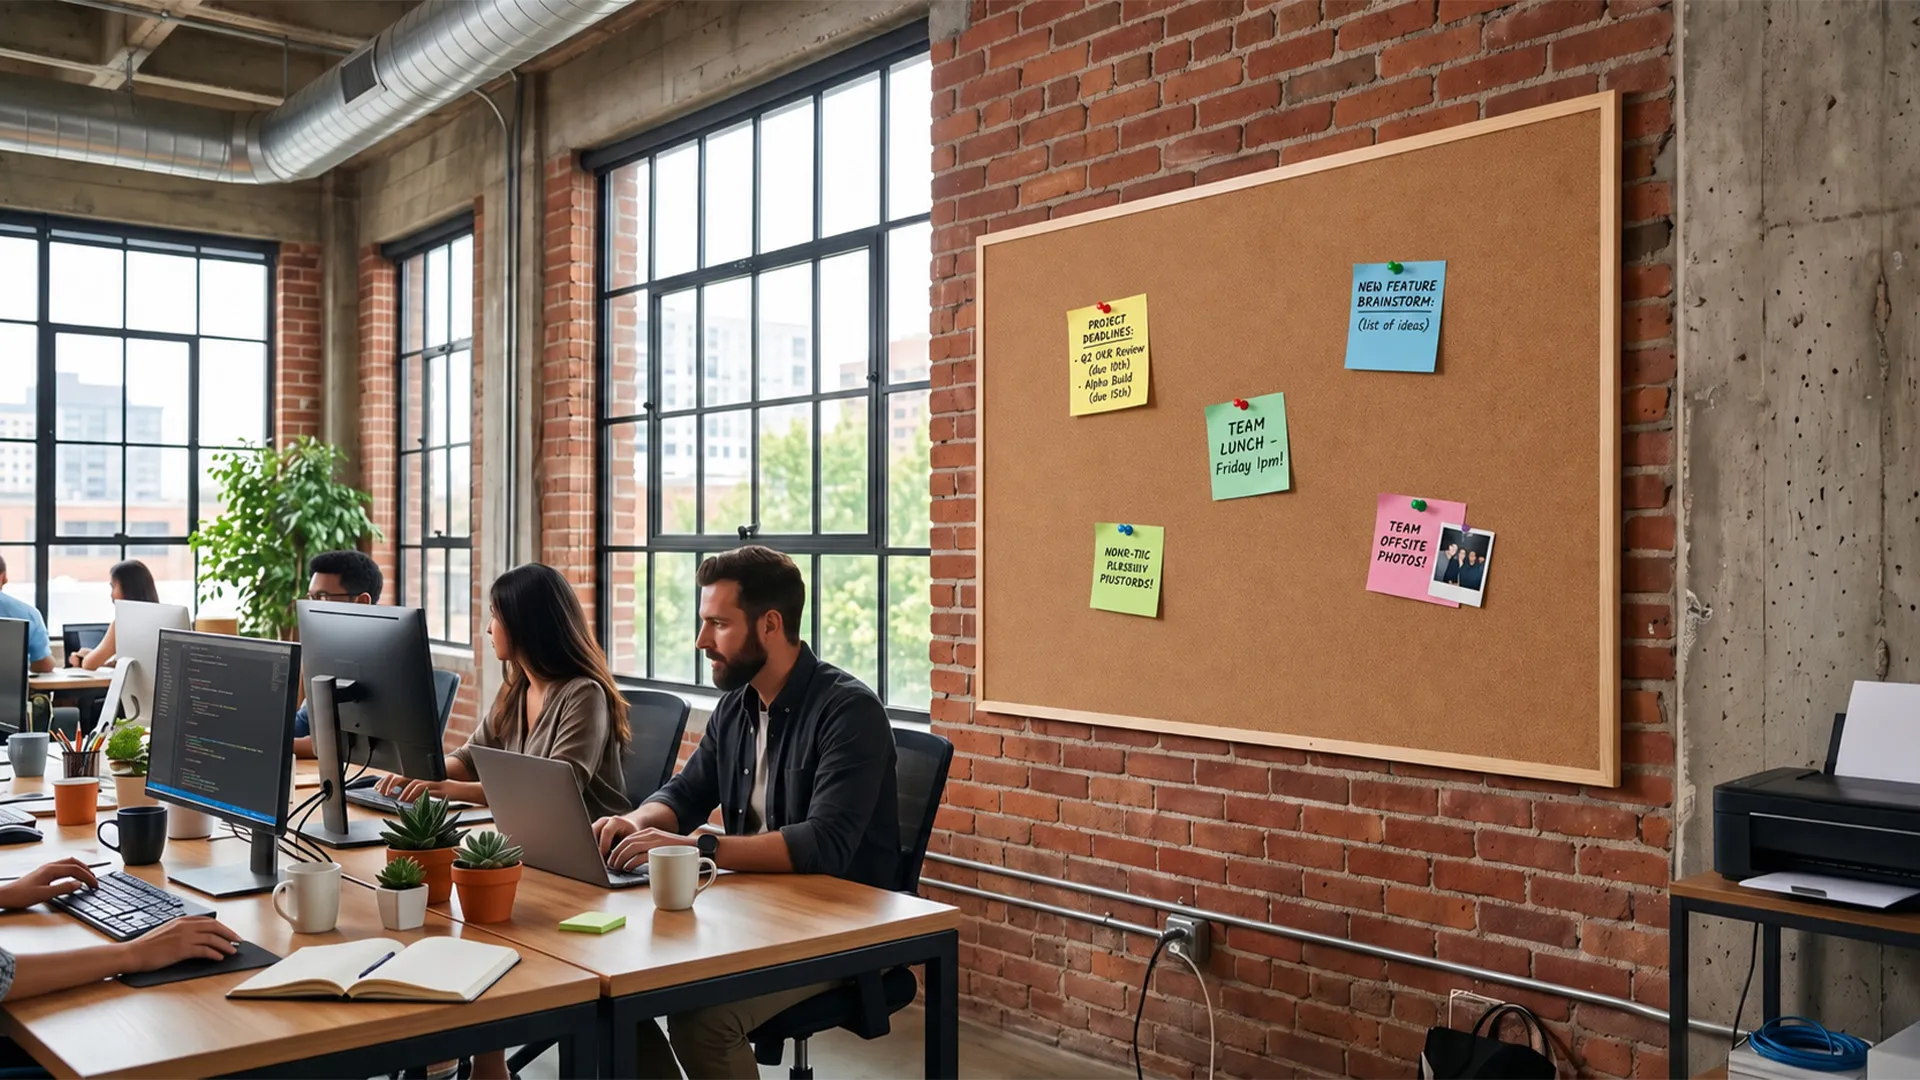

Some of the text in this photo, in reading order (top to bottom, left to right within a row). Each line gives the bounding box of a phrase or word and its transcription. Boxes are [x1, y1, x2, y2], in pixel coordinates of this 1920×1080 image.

[1358, 280, 1437, 292] NEW FEATURE
[1357, 296, 1434, 307] BRAINSTORM:
[1088, 314, 1126, 330] PROJECT
[1358, 317, 1430, 332] (list of ideas)
[1083, 326, 1133, 344] DEADLINES:
[1080, 352, 1092, 364] Q2
[1116, 345, 1145, 357] Review
[1088, 358, 1131, 376] (due 10th)
[1085, 372, 1133, 391] Alpha Build
[1089, 386, 1131, 404] (due 15th)
[1228, 417, 1265, 436] TEAM
[1220, 436, 1264, 456] LUNCH
[1216, 451, 1284, 476] Friday 1pm!
[1389, 521, 1421, 534] TEAM
[1380, 536, 1427, 551] OFFSITE
[1377, 550, 1427, 568] PHOTOS!
